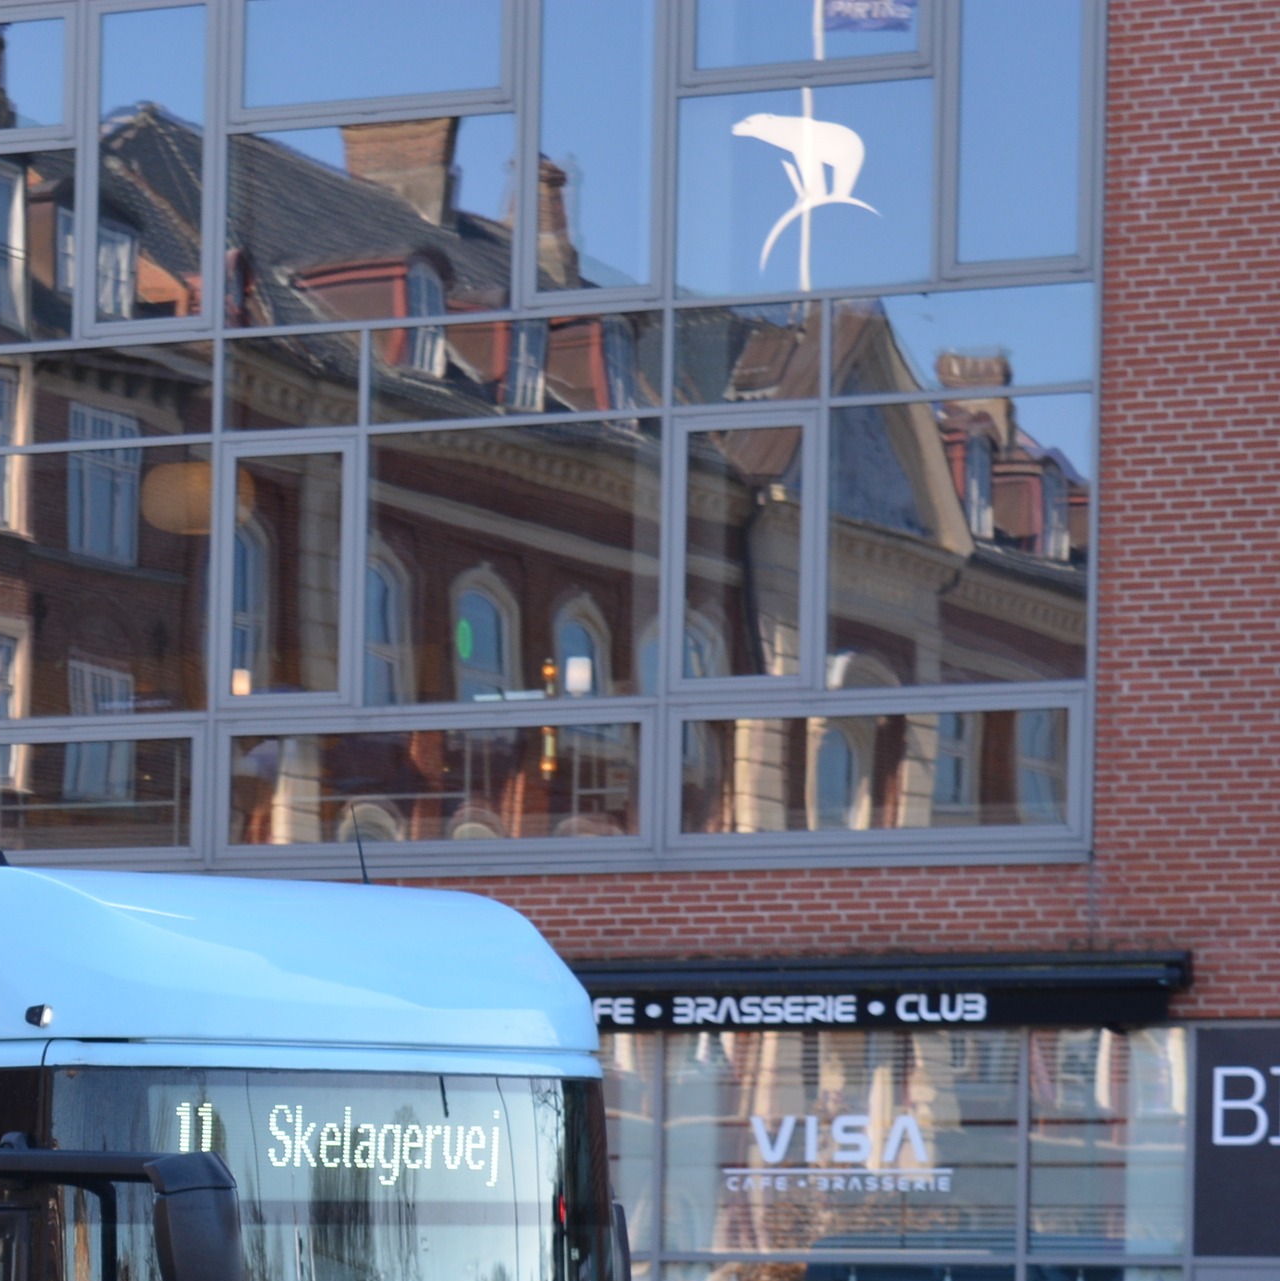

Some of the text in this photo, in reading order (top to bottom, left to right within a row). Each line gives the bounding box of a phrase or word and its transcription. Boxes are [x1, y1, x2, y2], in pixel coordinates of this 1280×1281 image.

[673, 994, 857, 1025] BRASSERIE
[895, 993, 988, 1022] CLUB
[1211, 1066, 1280, 1146] B
[175, 1102, 501, 1187] 11 Skelagervej
[750, 1115, 929, 1164] VISA
[726, 1174, 952, 1192] CAFE BRASSERIE
